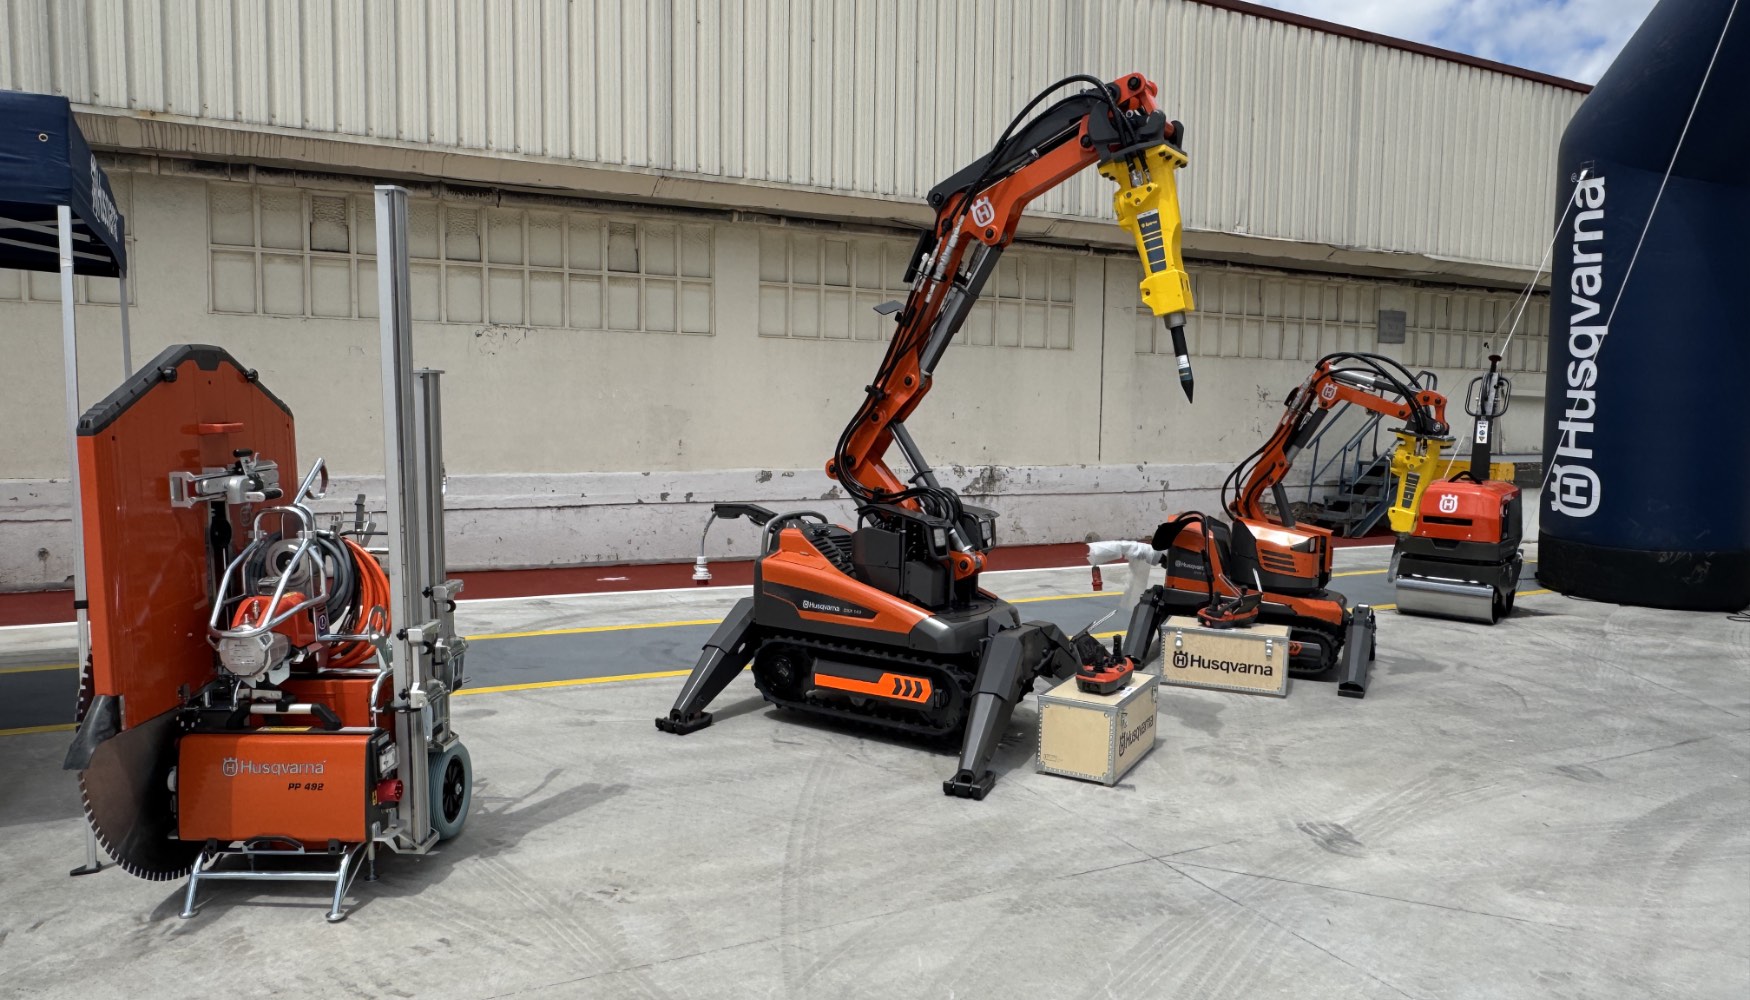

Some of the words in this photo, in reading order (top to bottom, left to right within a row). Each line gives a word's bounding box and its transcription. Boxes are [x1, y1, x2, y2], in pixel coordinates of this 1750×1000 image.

[1558, 176, 1609, 460] Husqvarna
[808, 601, 840, 612] Husqvarna
[1190, 654, 1273, 676] Husqvarna
[240, 760, 324, 776] Husqvarna
[287, 782, 302, 791] PP
[304, 782, 325, 792] 492
